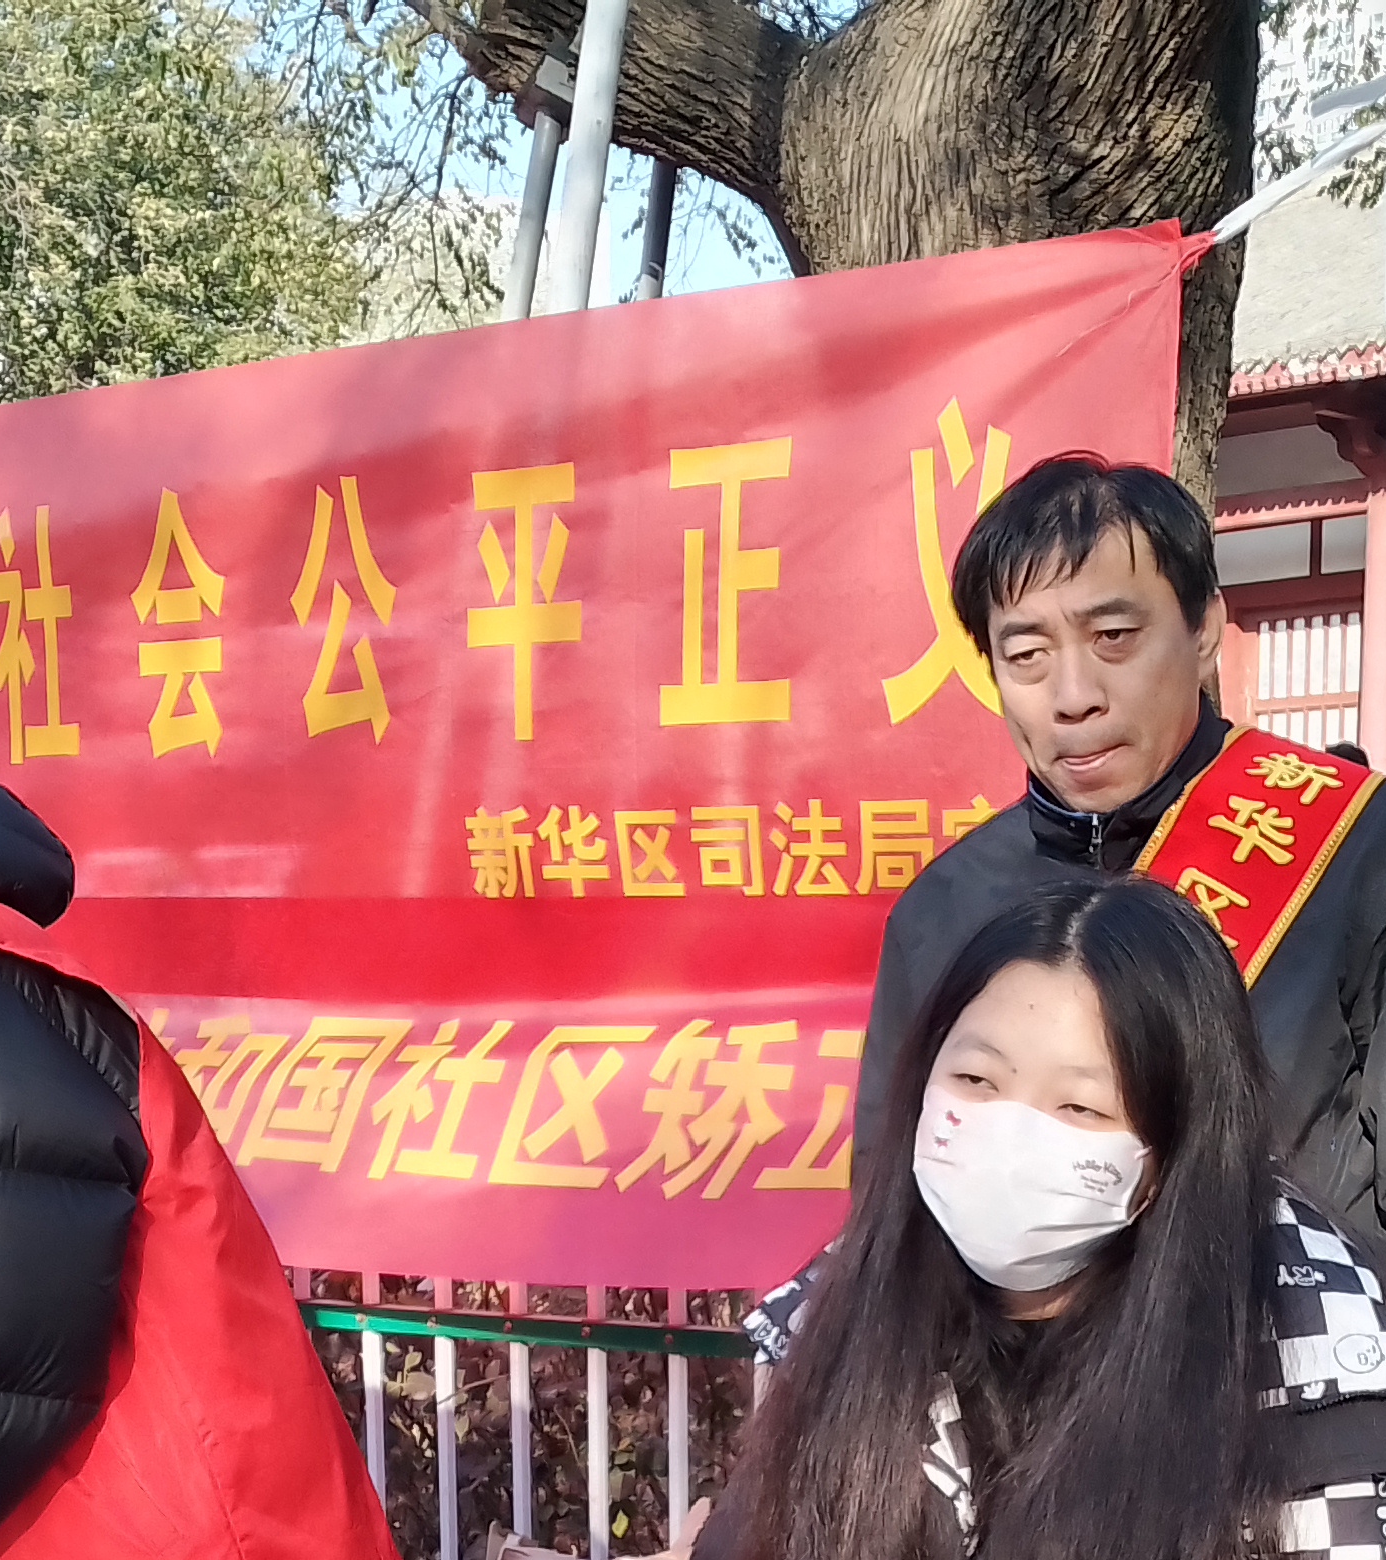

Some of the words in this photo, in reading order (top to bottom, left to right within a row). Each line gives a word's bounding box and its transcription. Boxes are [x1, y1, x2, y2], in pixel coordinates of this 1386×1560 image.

[1174, 751, 1346, 950] 新华区
[149, 1008, 867, 1201] 和国社区矫正
